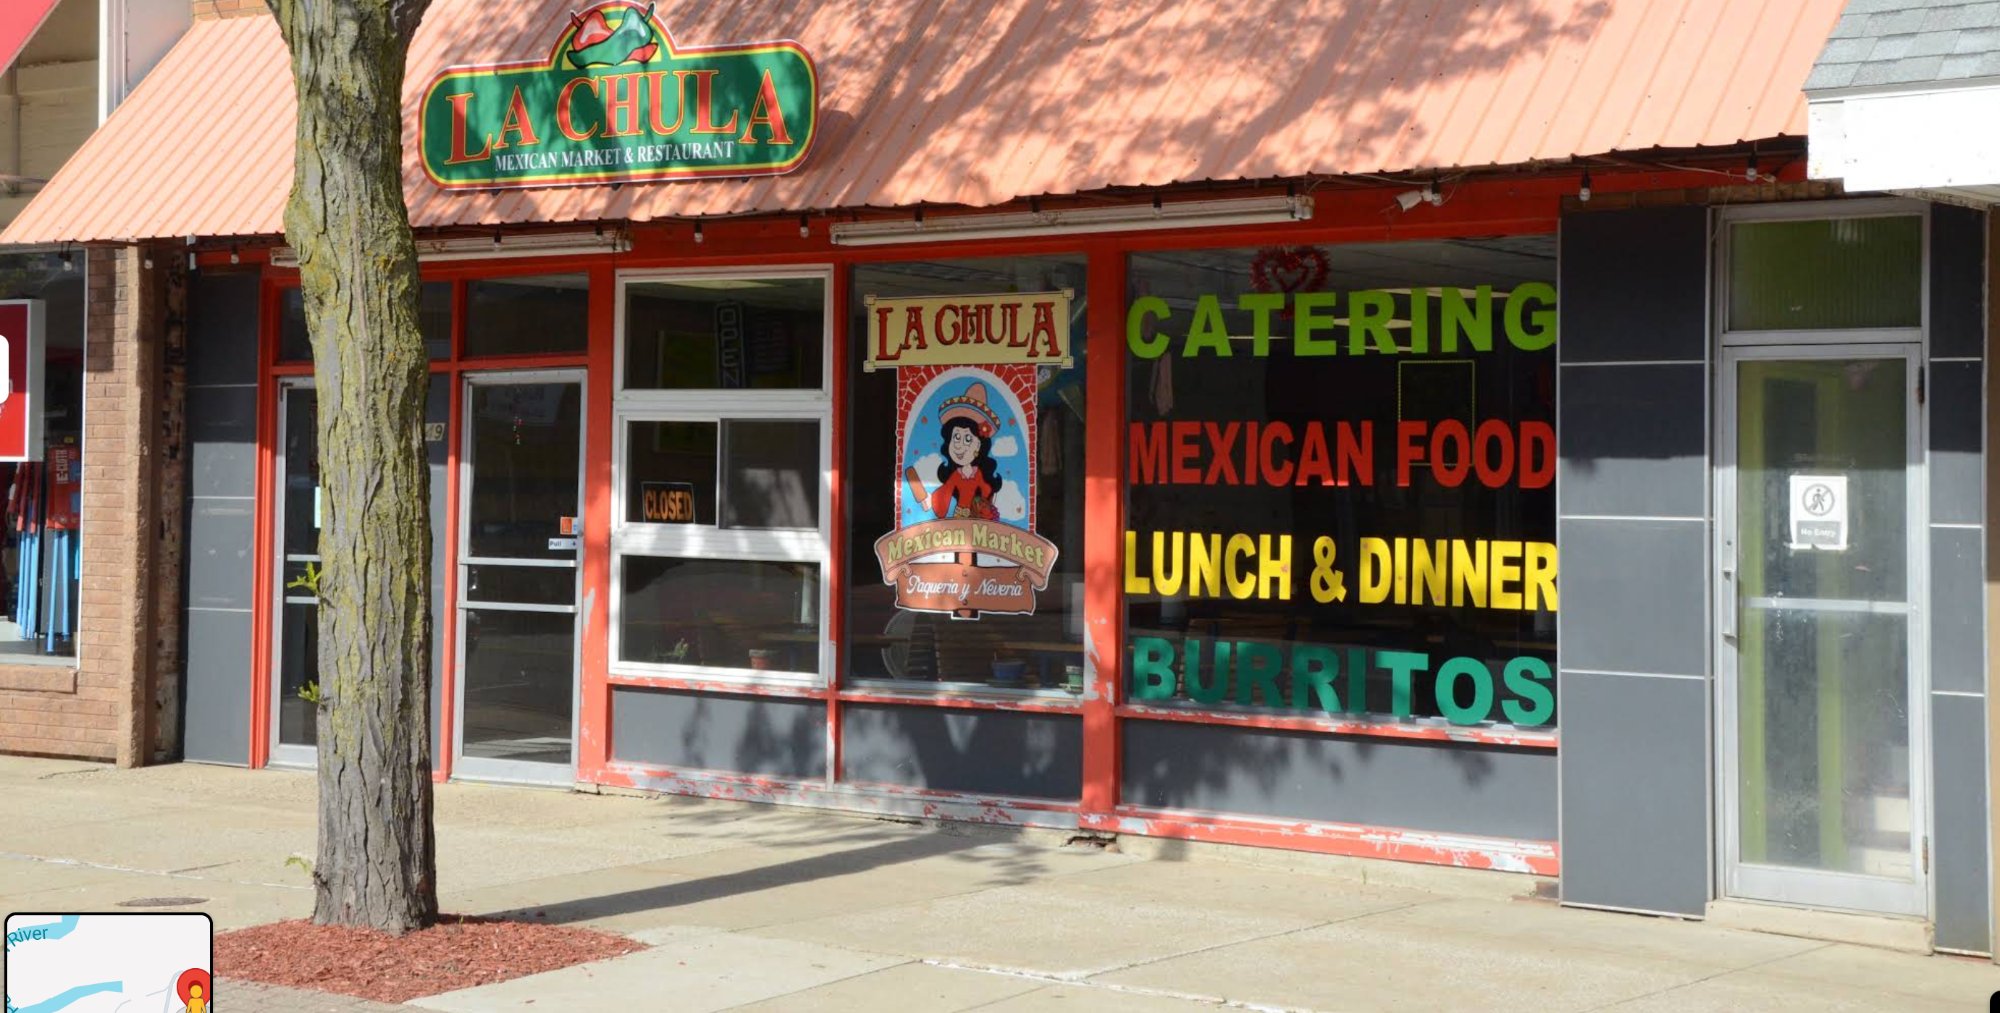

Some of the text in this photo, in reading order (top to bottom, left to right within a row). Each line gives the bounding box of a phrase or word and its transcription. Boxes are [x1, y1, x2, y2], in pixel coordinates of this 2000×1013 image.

[444, 68, 793, 165] LA CHULA
[495, 141, 734, 171] MEXICAN MARKET & RESTAURANT
[719, 307, 740, 388] OPEN
[875, 301, 1061, 361] LA CHULA
[1126, 282, 1557, 359] CATERING
[1129, 418, 1556, 488] MEXICAN FOOD
[645, 490, 692, 520] CLOSED
[887, 523, 1044, 568] Mexican Market
[1124, 530, 1557, 611] LUNCH & DINNER
[959, 585, 970, 600] y
[974, 578, 1023, 597] Neveria
[1133, 636, 1554, 726] BURRITOS
